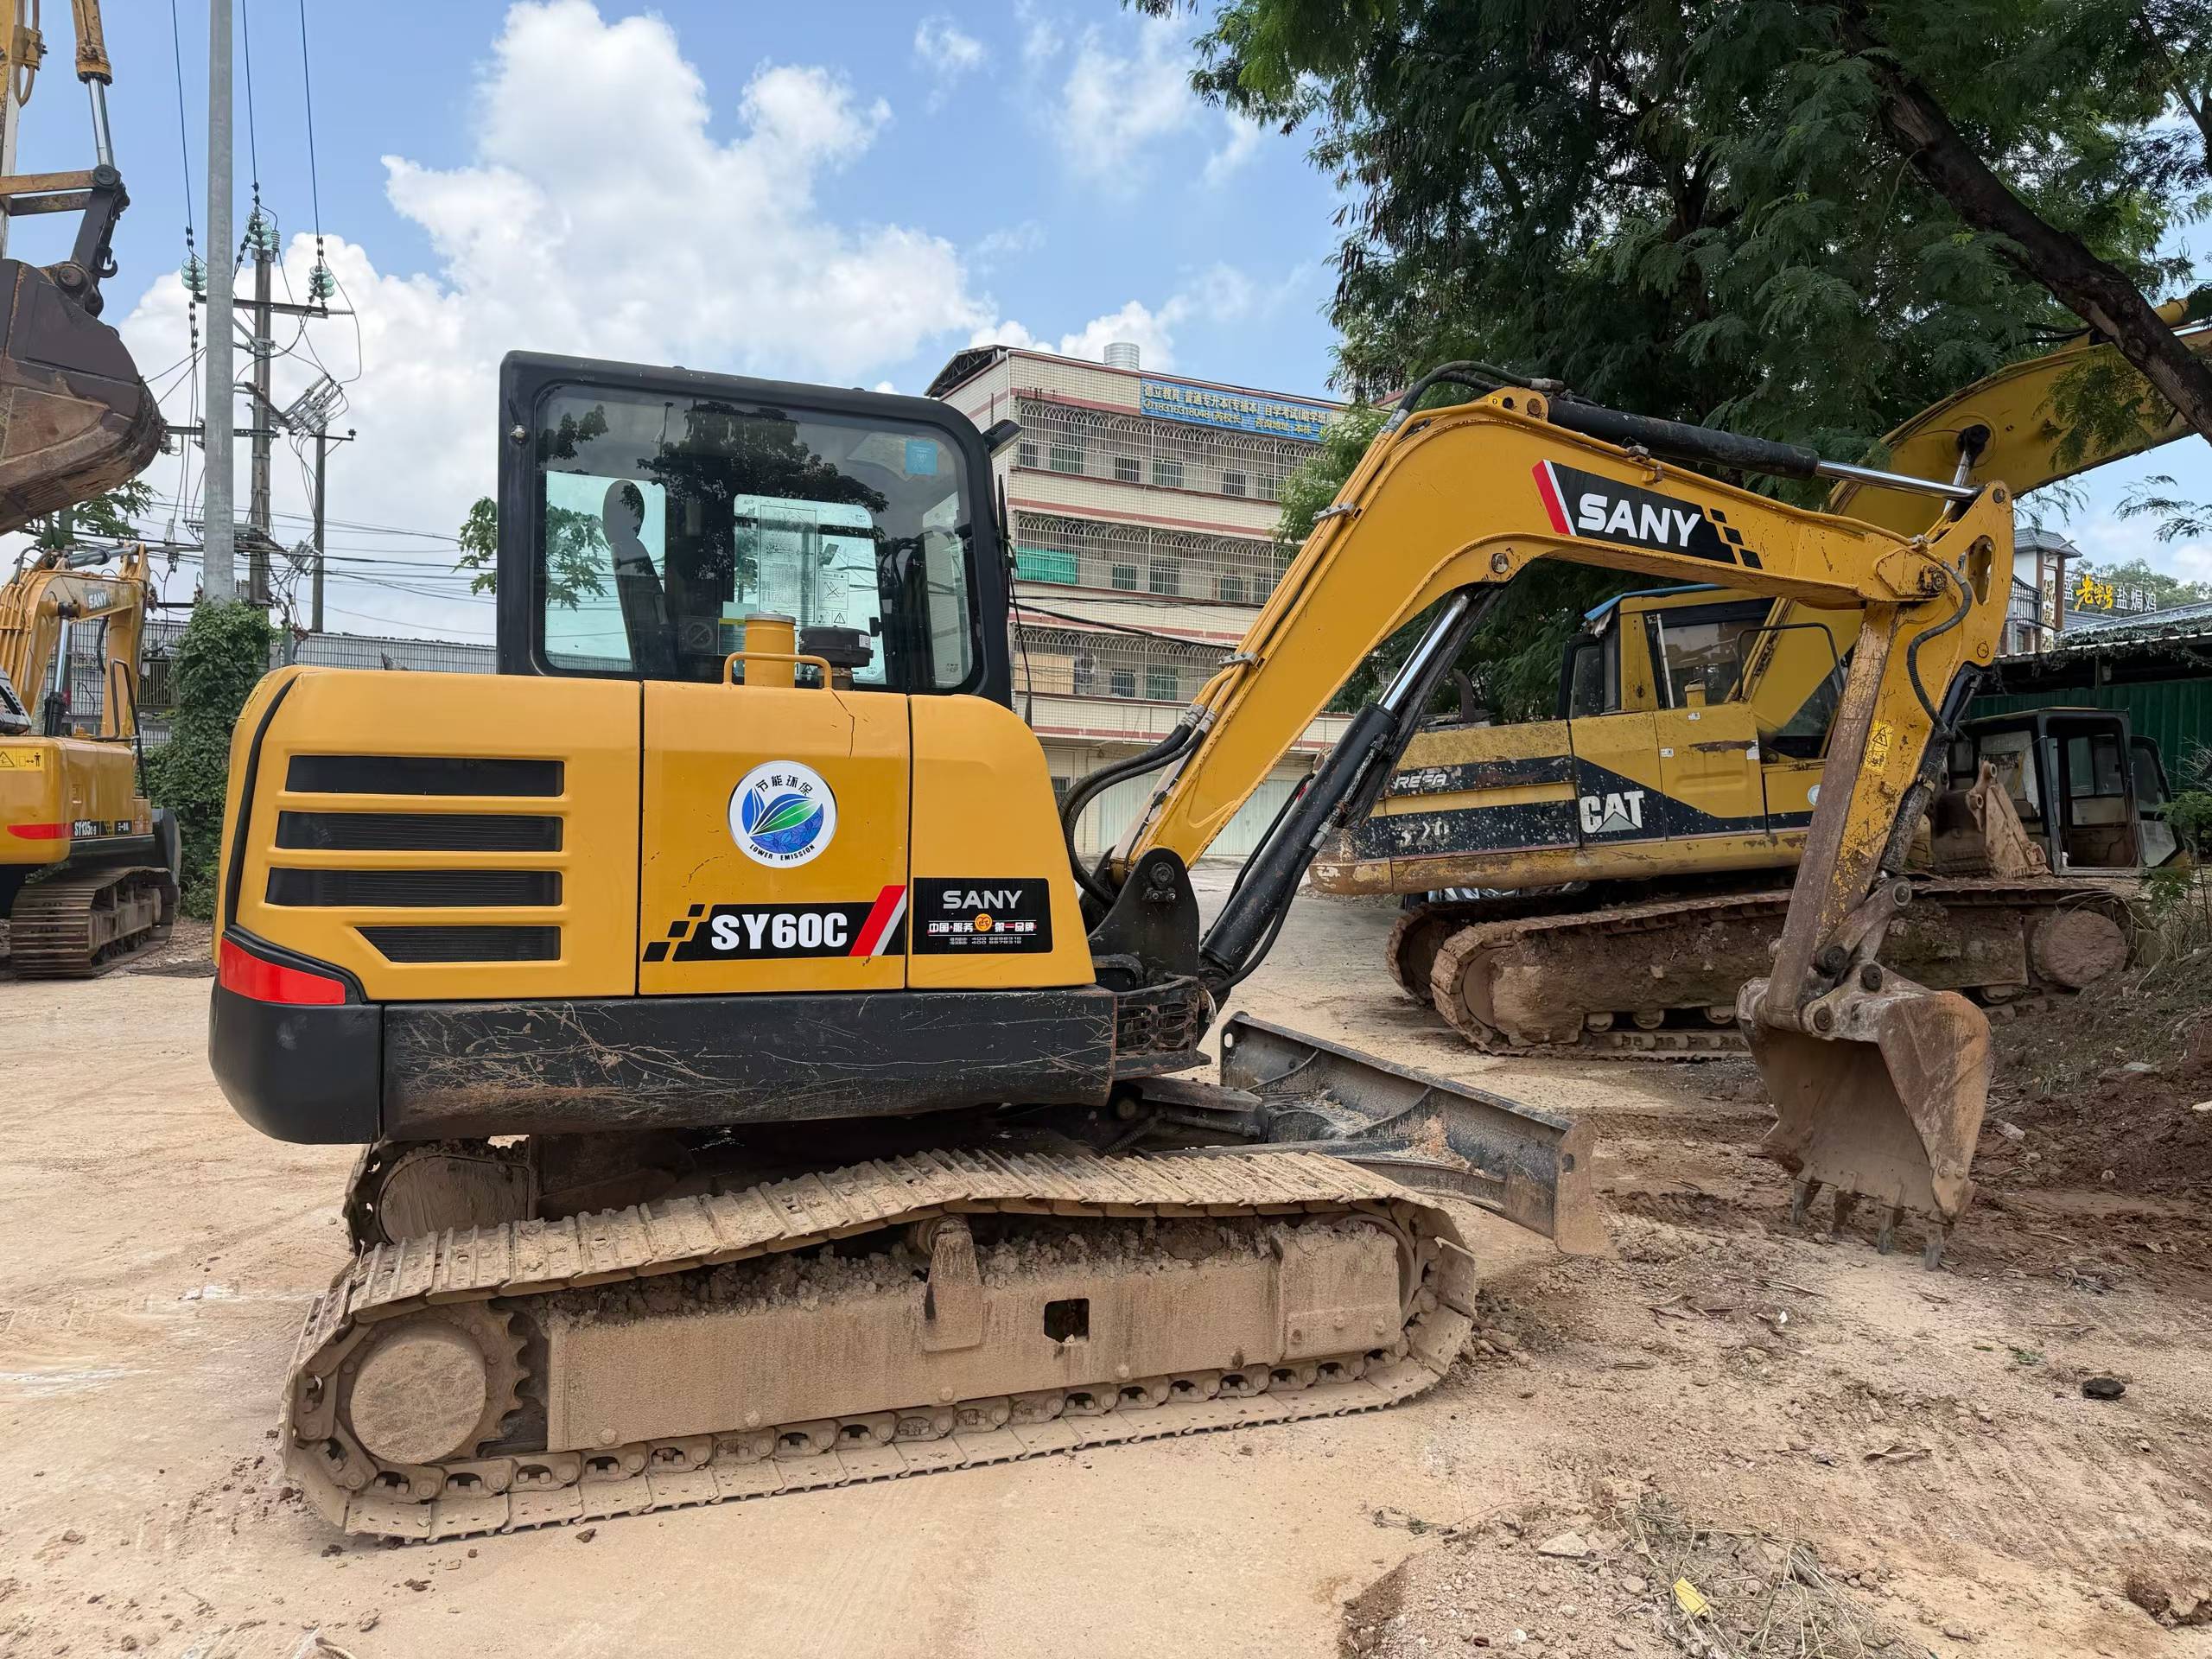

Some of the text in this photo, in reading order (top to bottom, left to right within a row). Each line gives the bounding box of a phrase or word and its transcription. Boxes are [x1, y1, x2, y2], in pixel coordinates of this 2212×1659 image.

[1578, 492, 1701, 547] SANY
[88, 591, 108, 609] SANY
[755, 774, 813, 796] 节能环保
[1579, 791, 1644, 834] CAT
[749, 843, 816, 861] LOWER EMISSION
[943, 890, 1023, 909] SANY
[711, 912, 848, 950] SY60C
